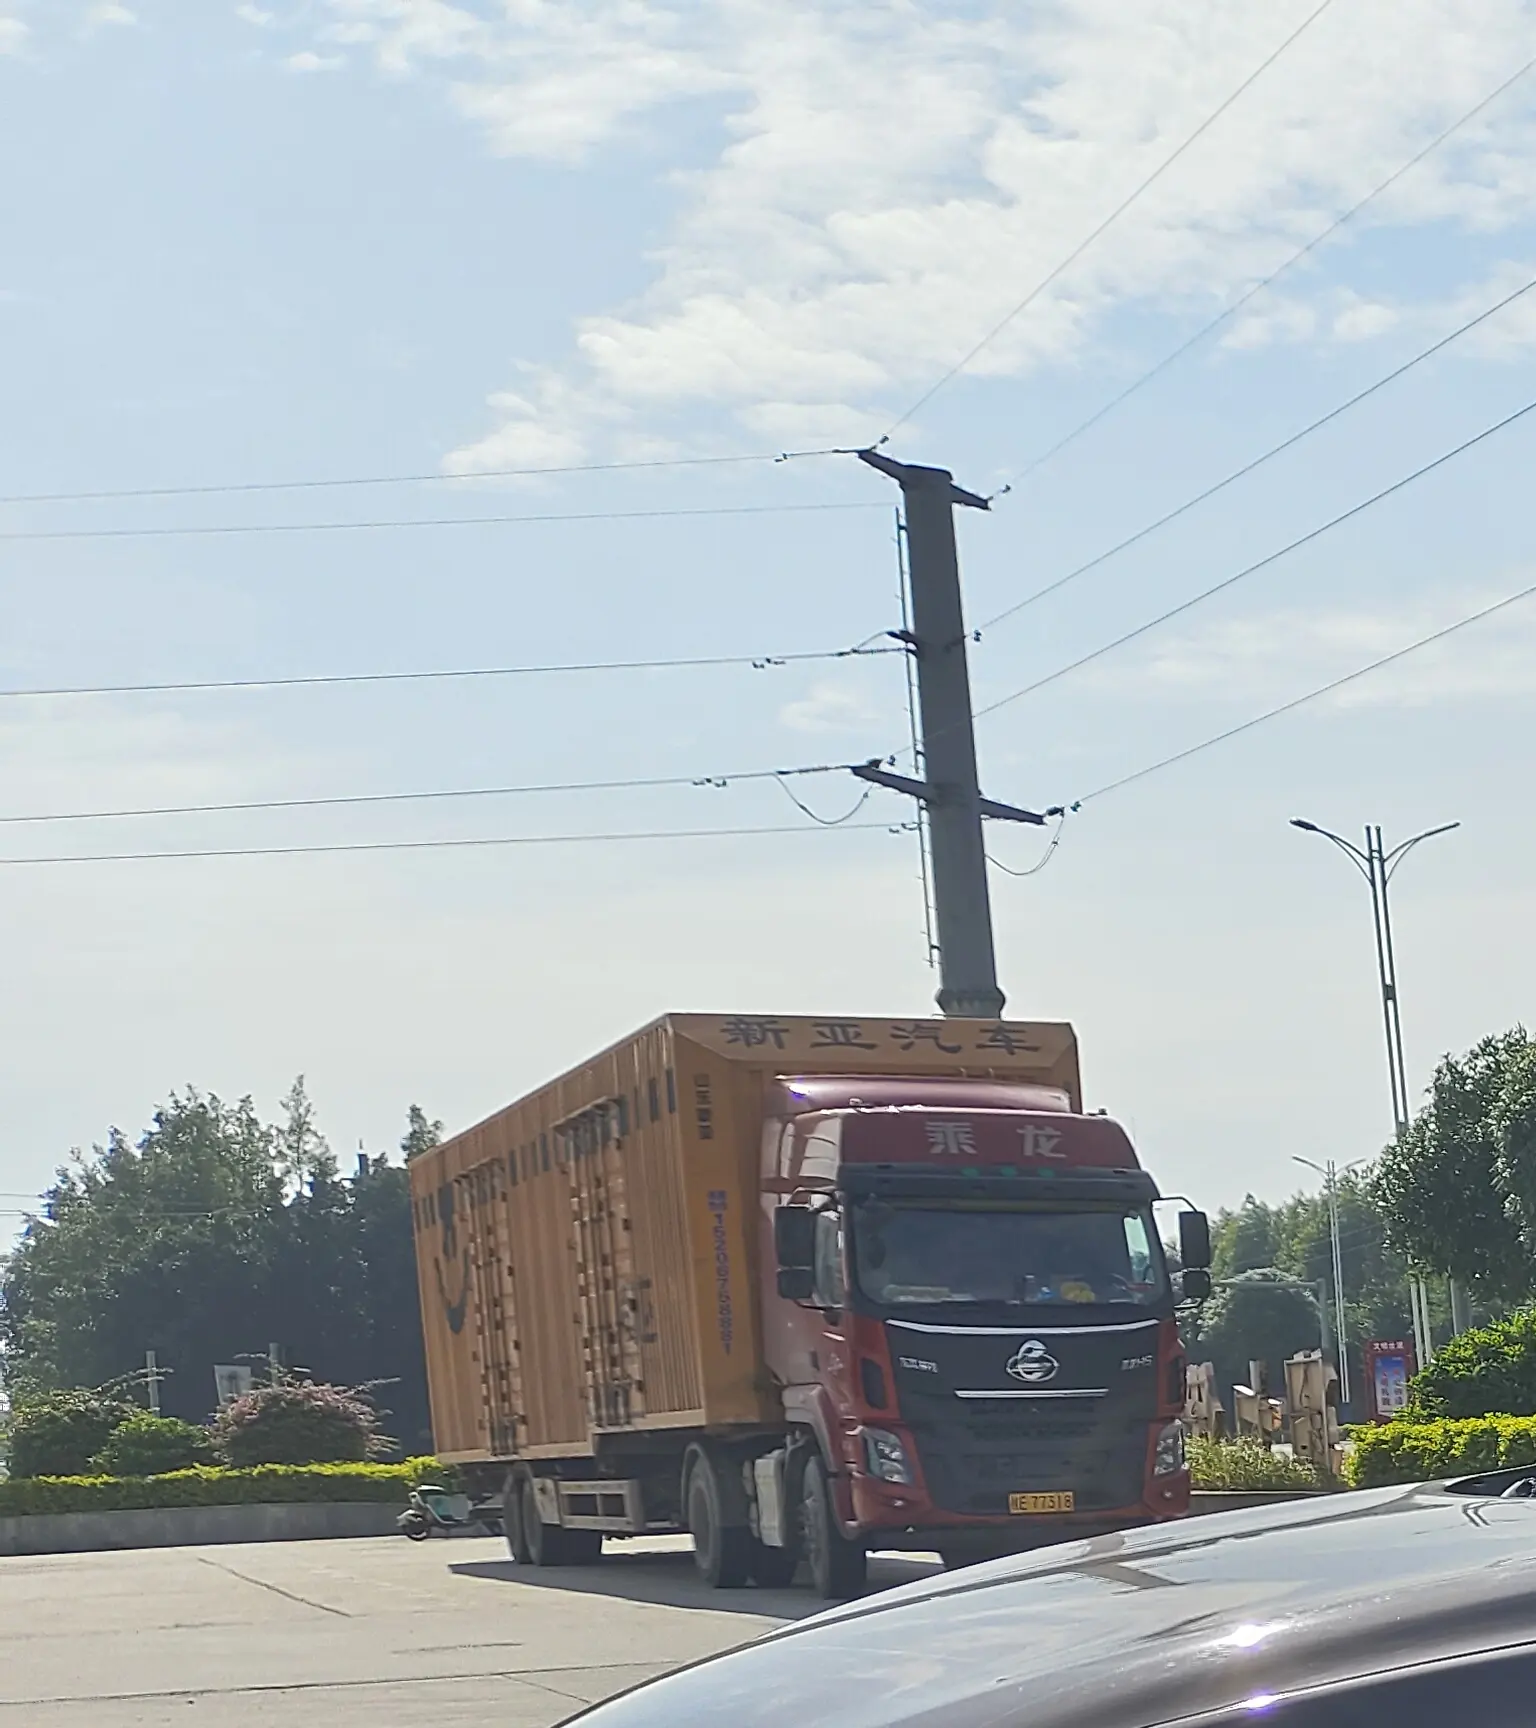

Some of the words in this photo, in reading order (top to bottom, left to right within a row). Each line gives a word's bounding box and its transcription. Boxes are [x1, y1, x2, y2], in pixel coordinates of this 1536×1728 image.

[720, 1017, 1041, 1056] 新亚汽车
[925, 1121, 1067, 1158] 乘龙
